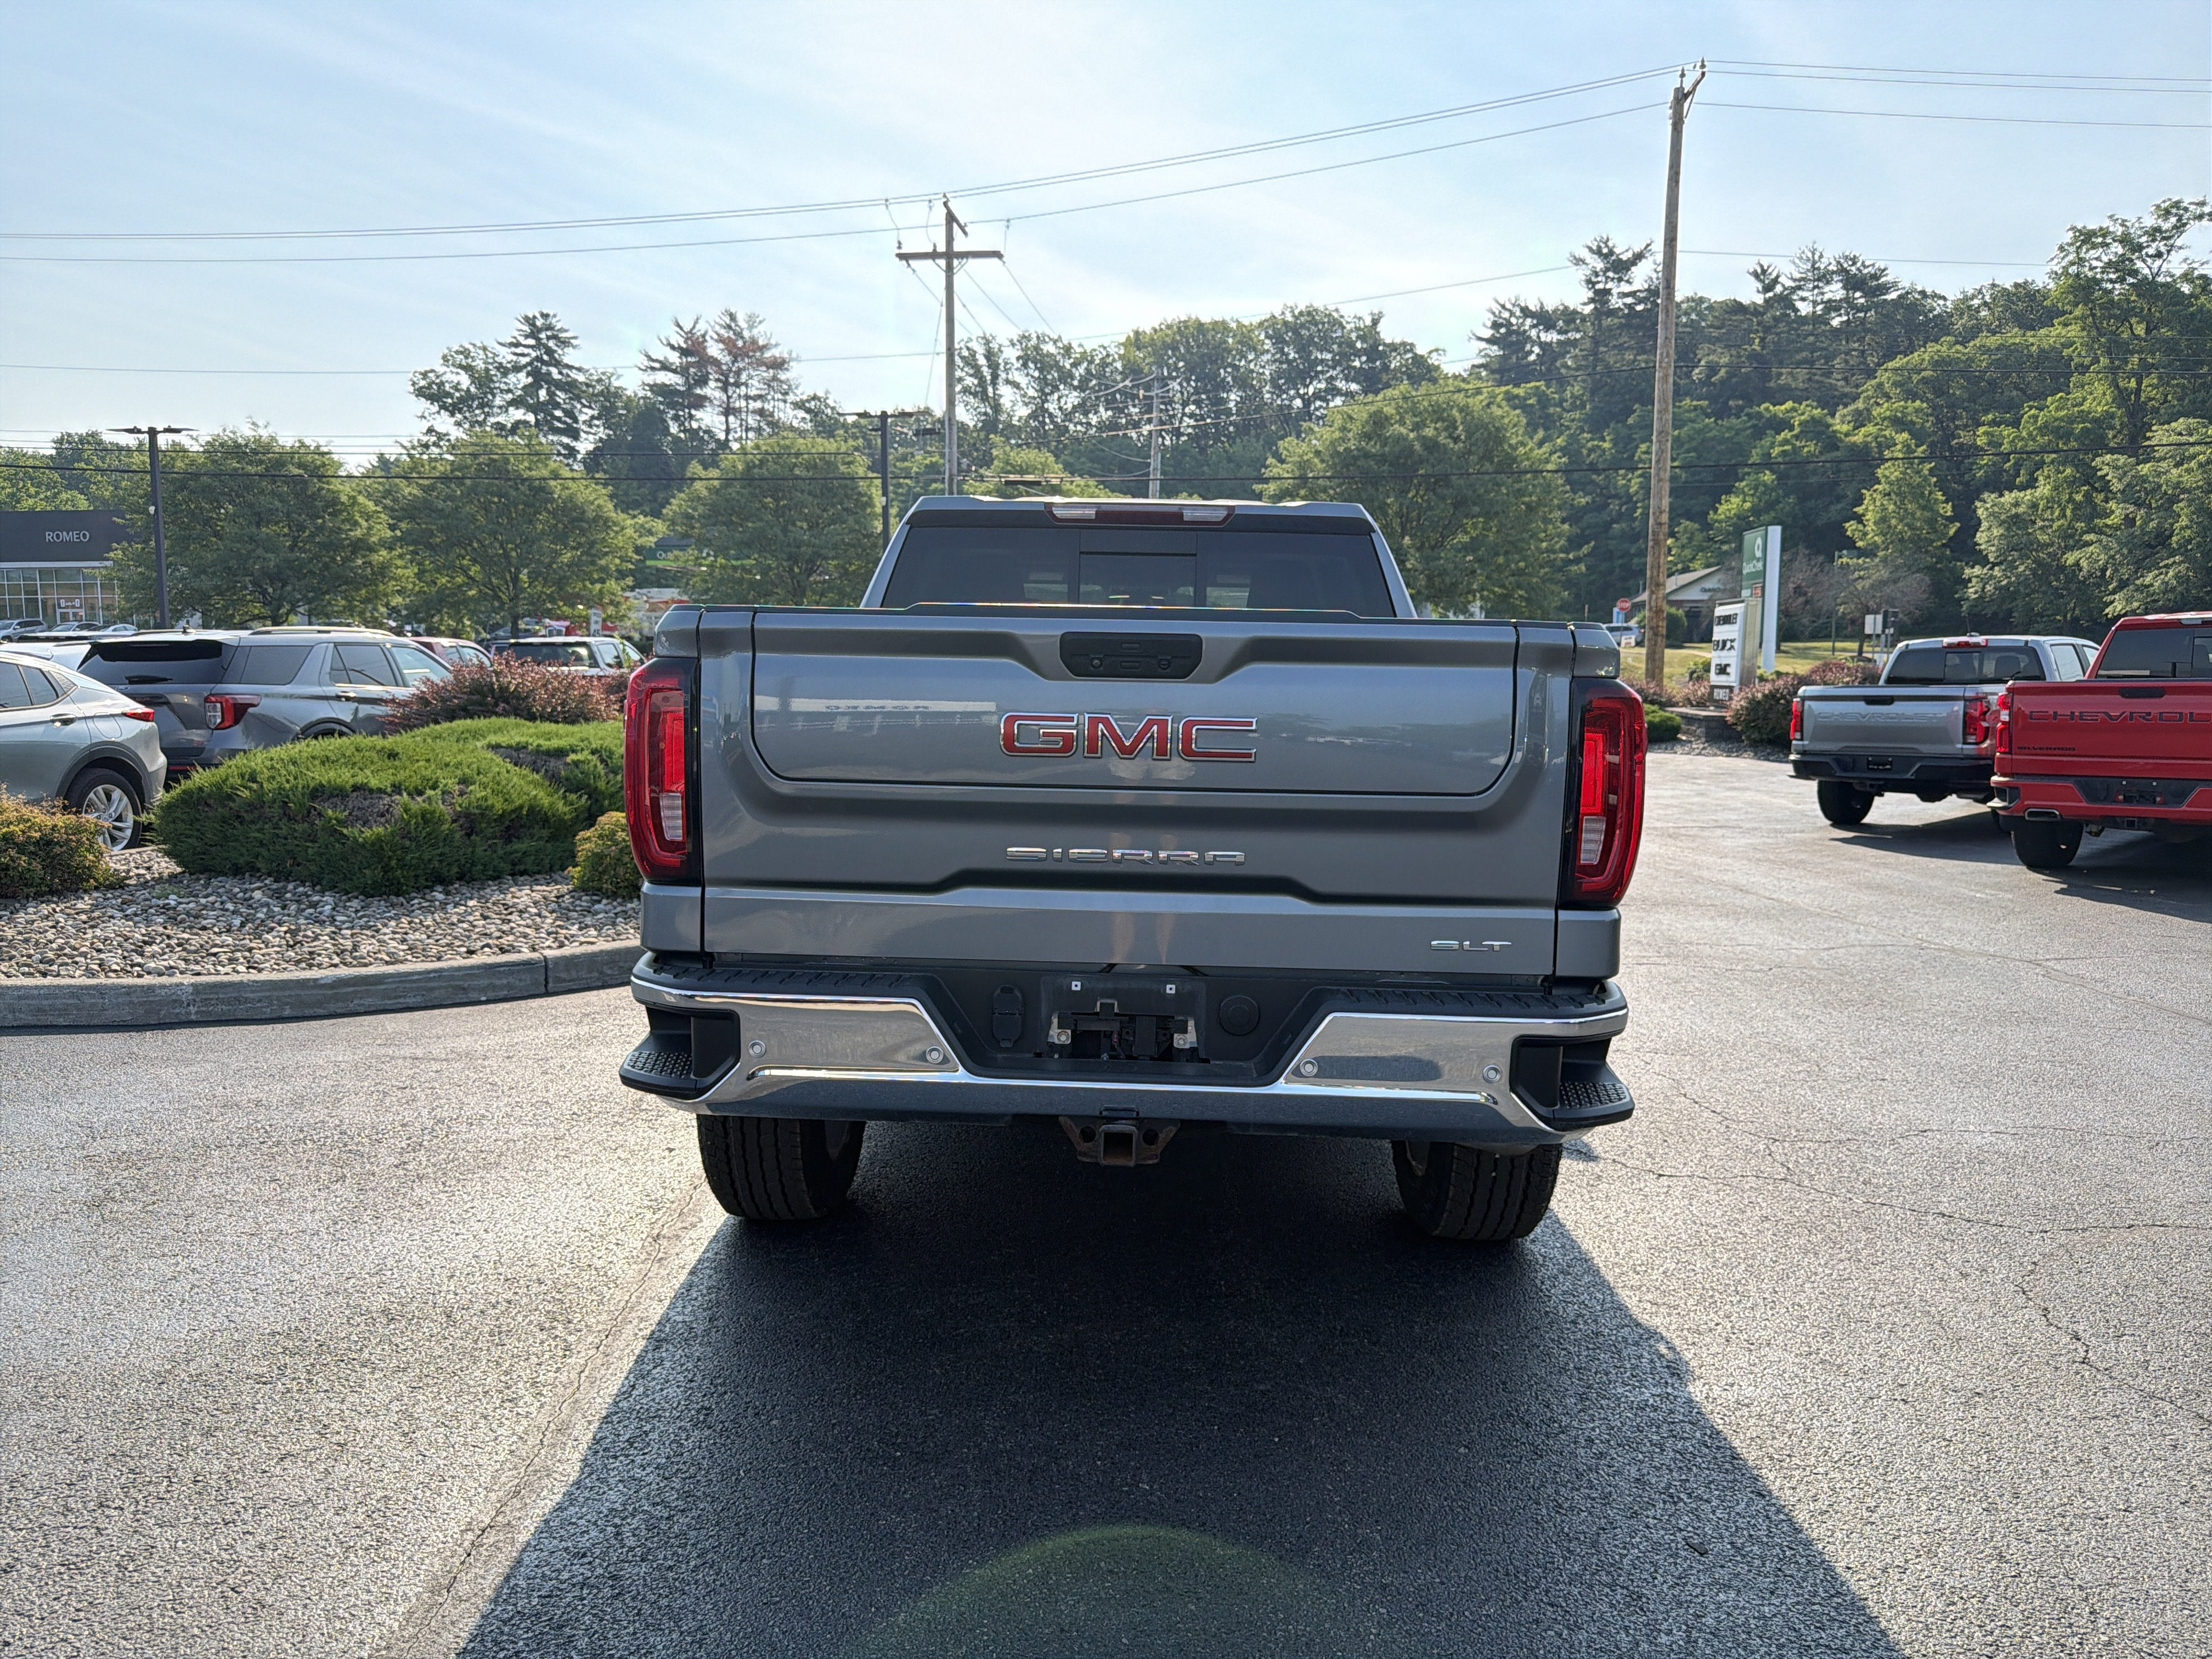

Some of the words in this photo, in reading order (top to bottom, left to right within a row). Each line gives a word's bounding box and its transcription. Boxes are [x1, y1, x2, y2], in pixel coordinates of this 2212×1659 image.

[45, 531, 90, 543] ROMEO
[1713, 638, 1736, 651] BUICK
[2029, 710, 2212, 723] CHEVROL
[999, 712, 1258, 763] GMC
[1005, 847, 1246, 866] SIERRA
[1430, 939, 1513, 952] SLT
